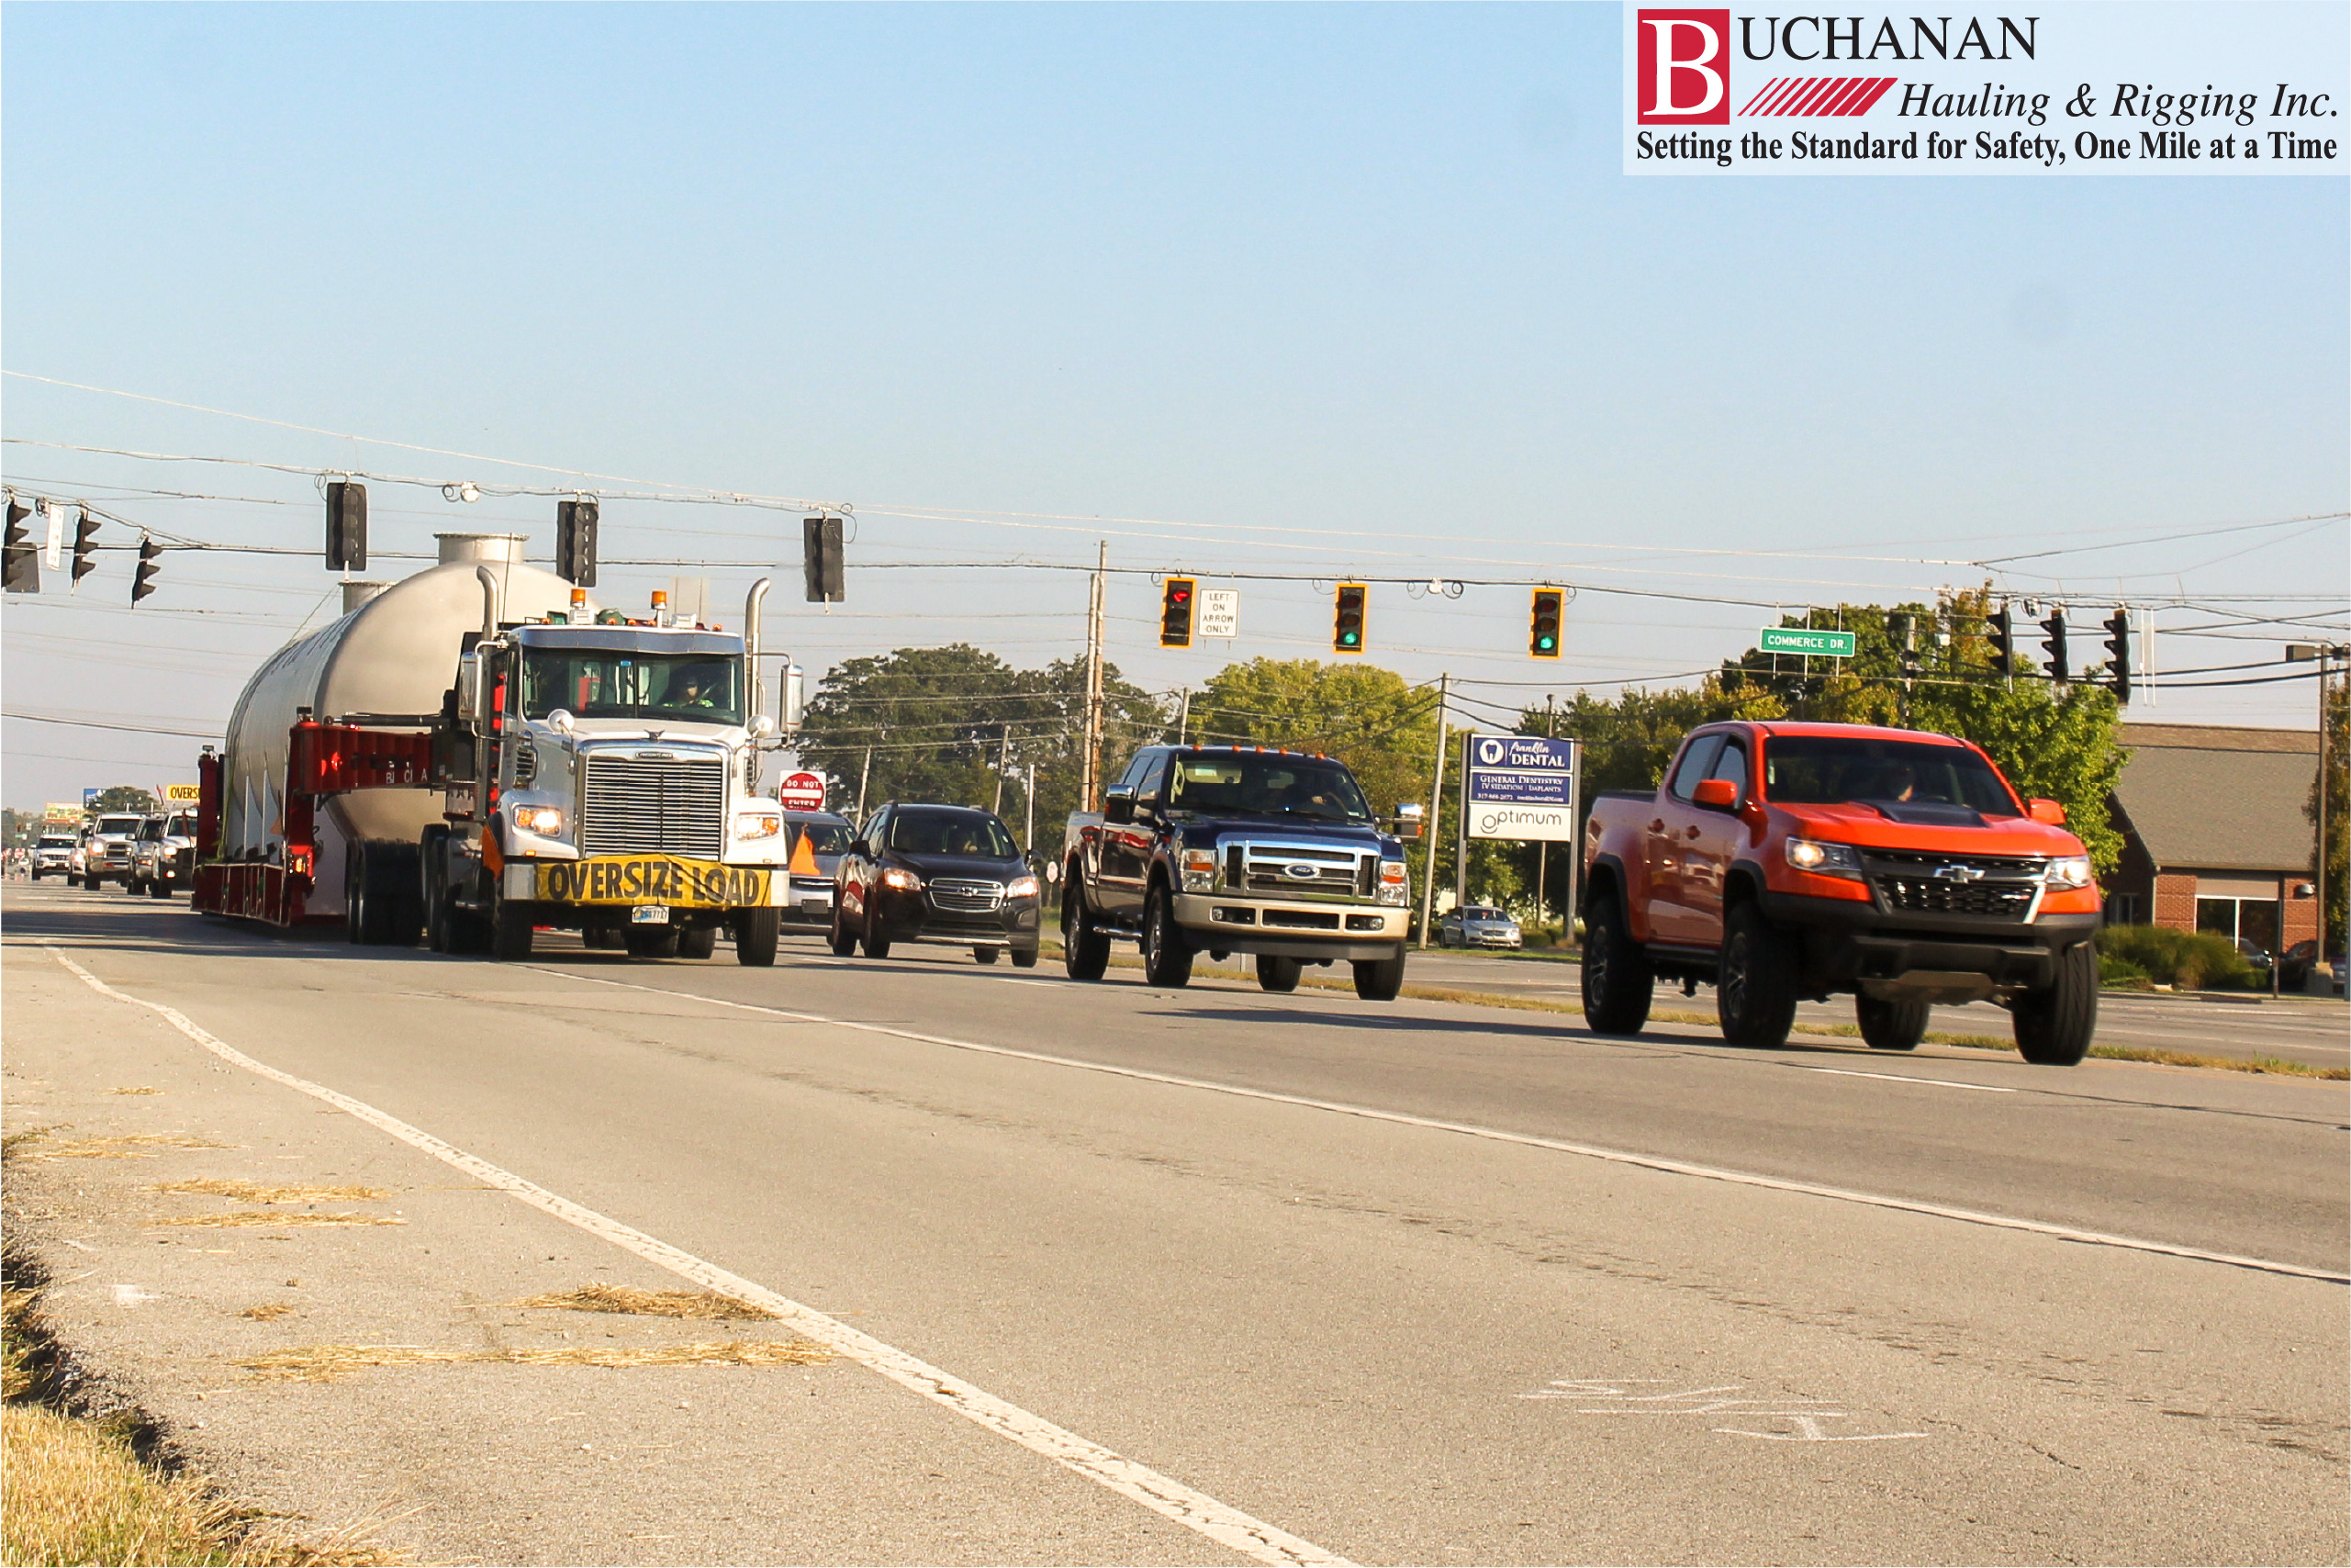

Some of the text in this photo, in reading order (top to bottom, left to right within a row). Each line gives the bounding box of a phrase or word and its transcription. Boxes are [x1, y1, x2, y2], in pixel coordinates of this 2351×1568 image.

[1209, 593, 1230, 601] LEFT
[1212, 603, 1226, 611] ON
[1203, 614, 1234, 623] ARROW
[1205, 624, 1229, 633] ONLY
[1767, 635, 1848, 650] COMMERCE DR.
[1511, 754, 1565, 767] DENTAL
[787, 779, 819, 789] DO NOT
[1480, 775, 1563, 785] GENERAL DENTISTRY
[547, 861, 760, 906] OVERSIZE LOAD
